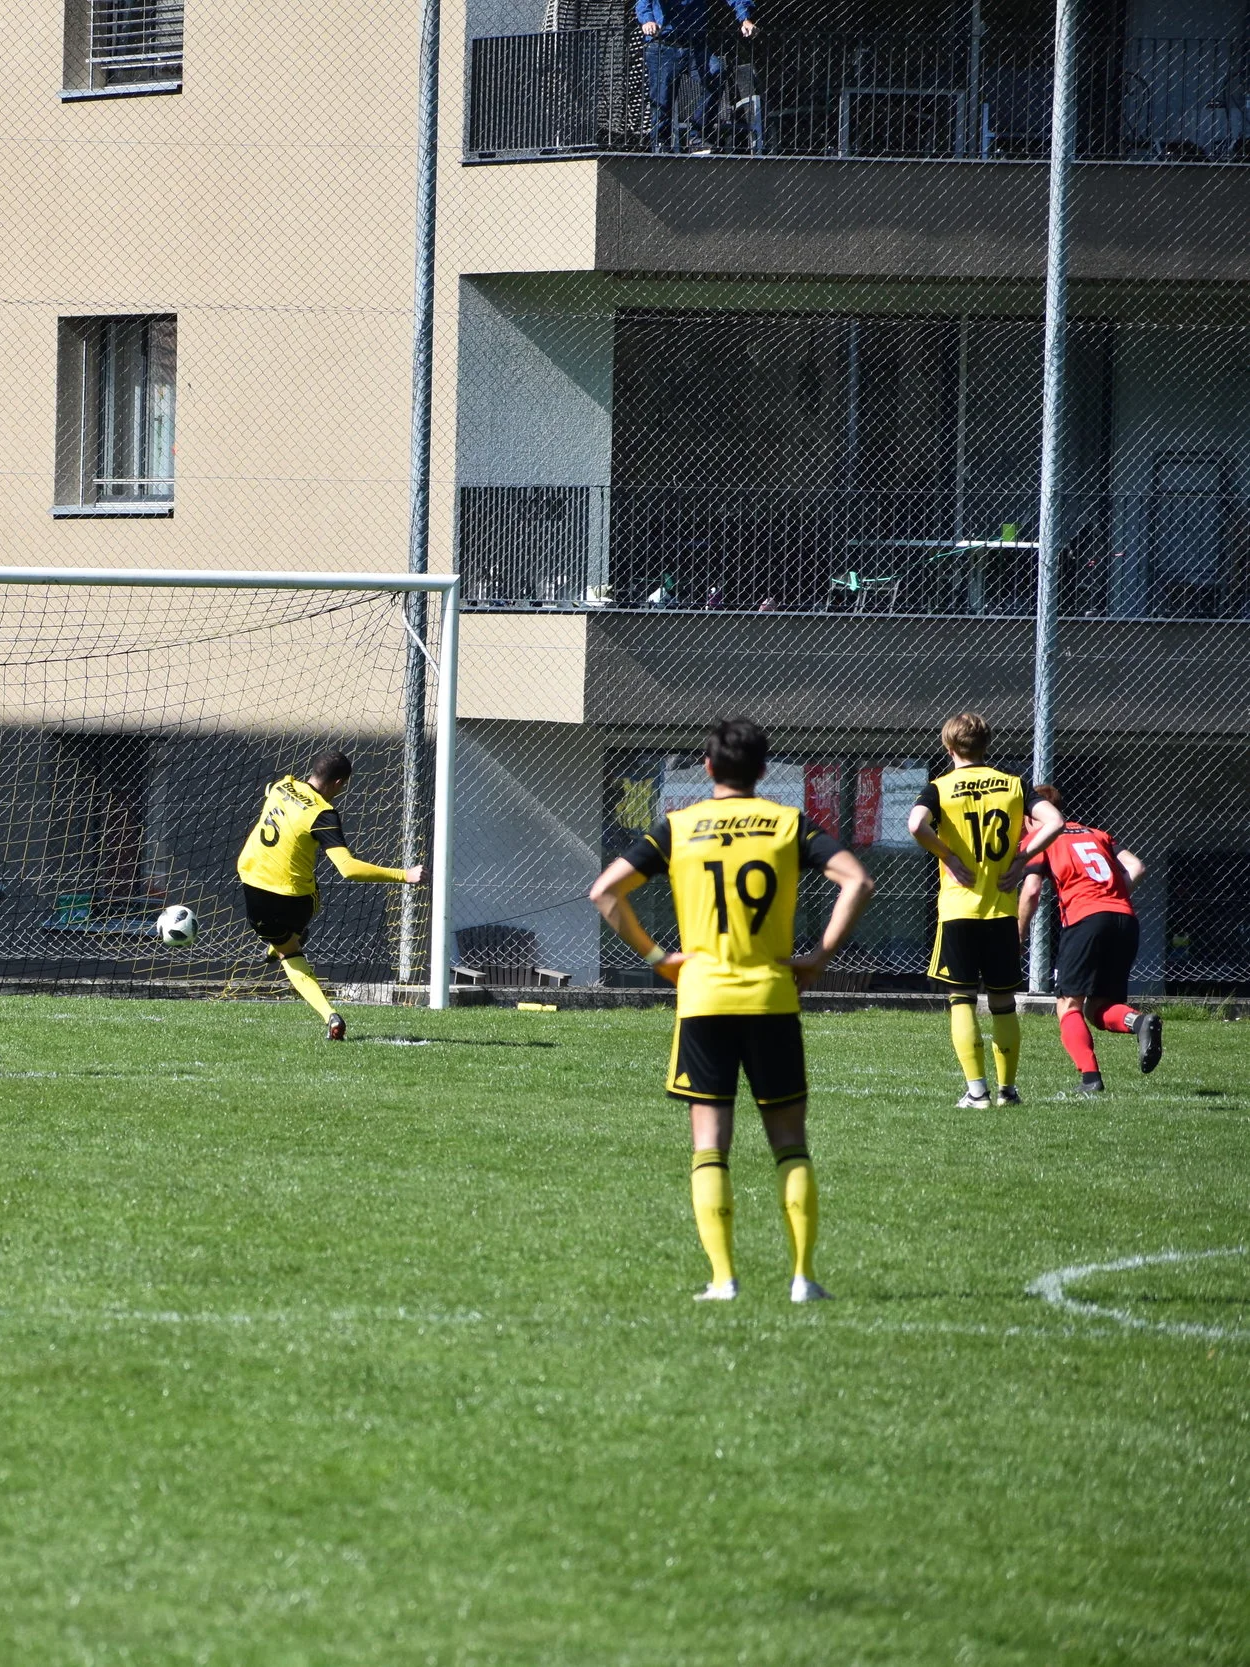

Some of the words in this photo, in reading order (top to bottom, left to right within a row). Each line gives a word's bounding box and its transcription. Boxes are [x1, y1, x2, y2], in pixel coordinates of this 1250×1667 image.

[953, 777, 1010, 793] Baldini
[260, 806, 285, 848] 5
[693, 815, 781, 834] Baldini
[964, 808, 1011, 864] 13
[1071, 841, 1112, 885] 5
[703, 859, 778, 936] 19
